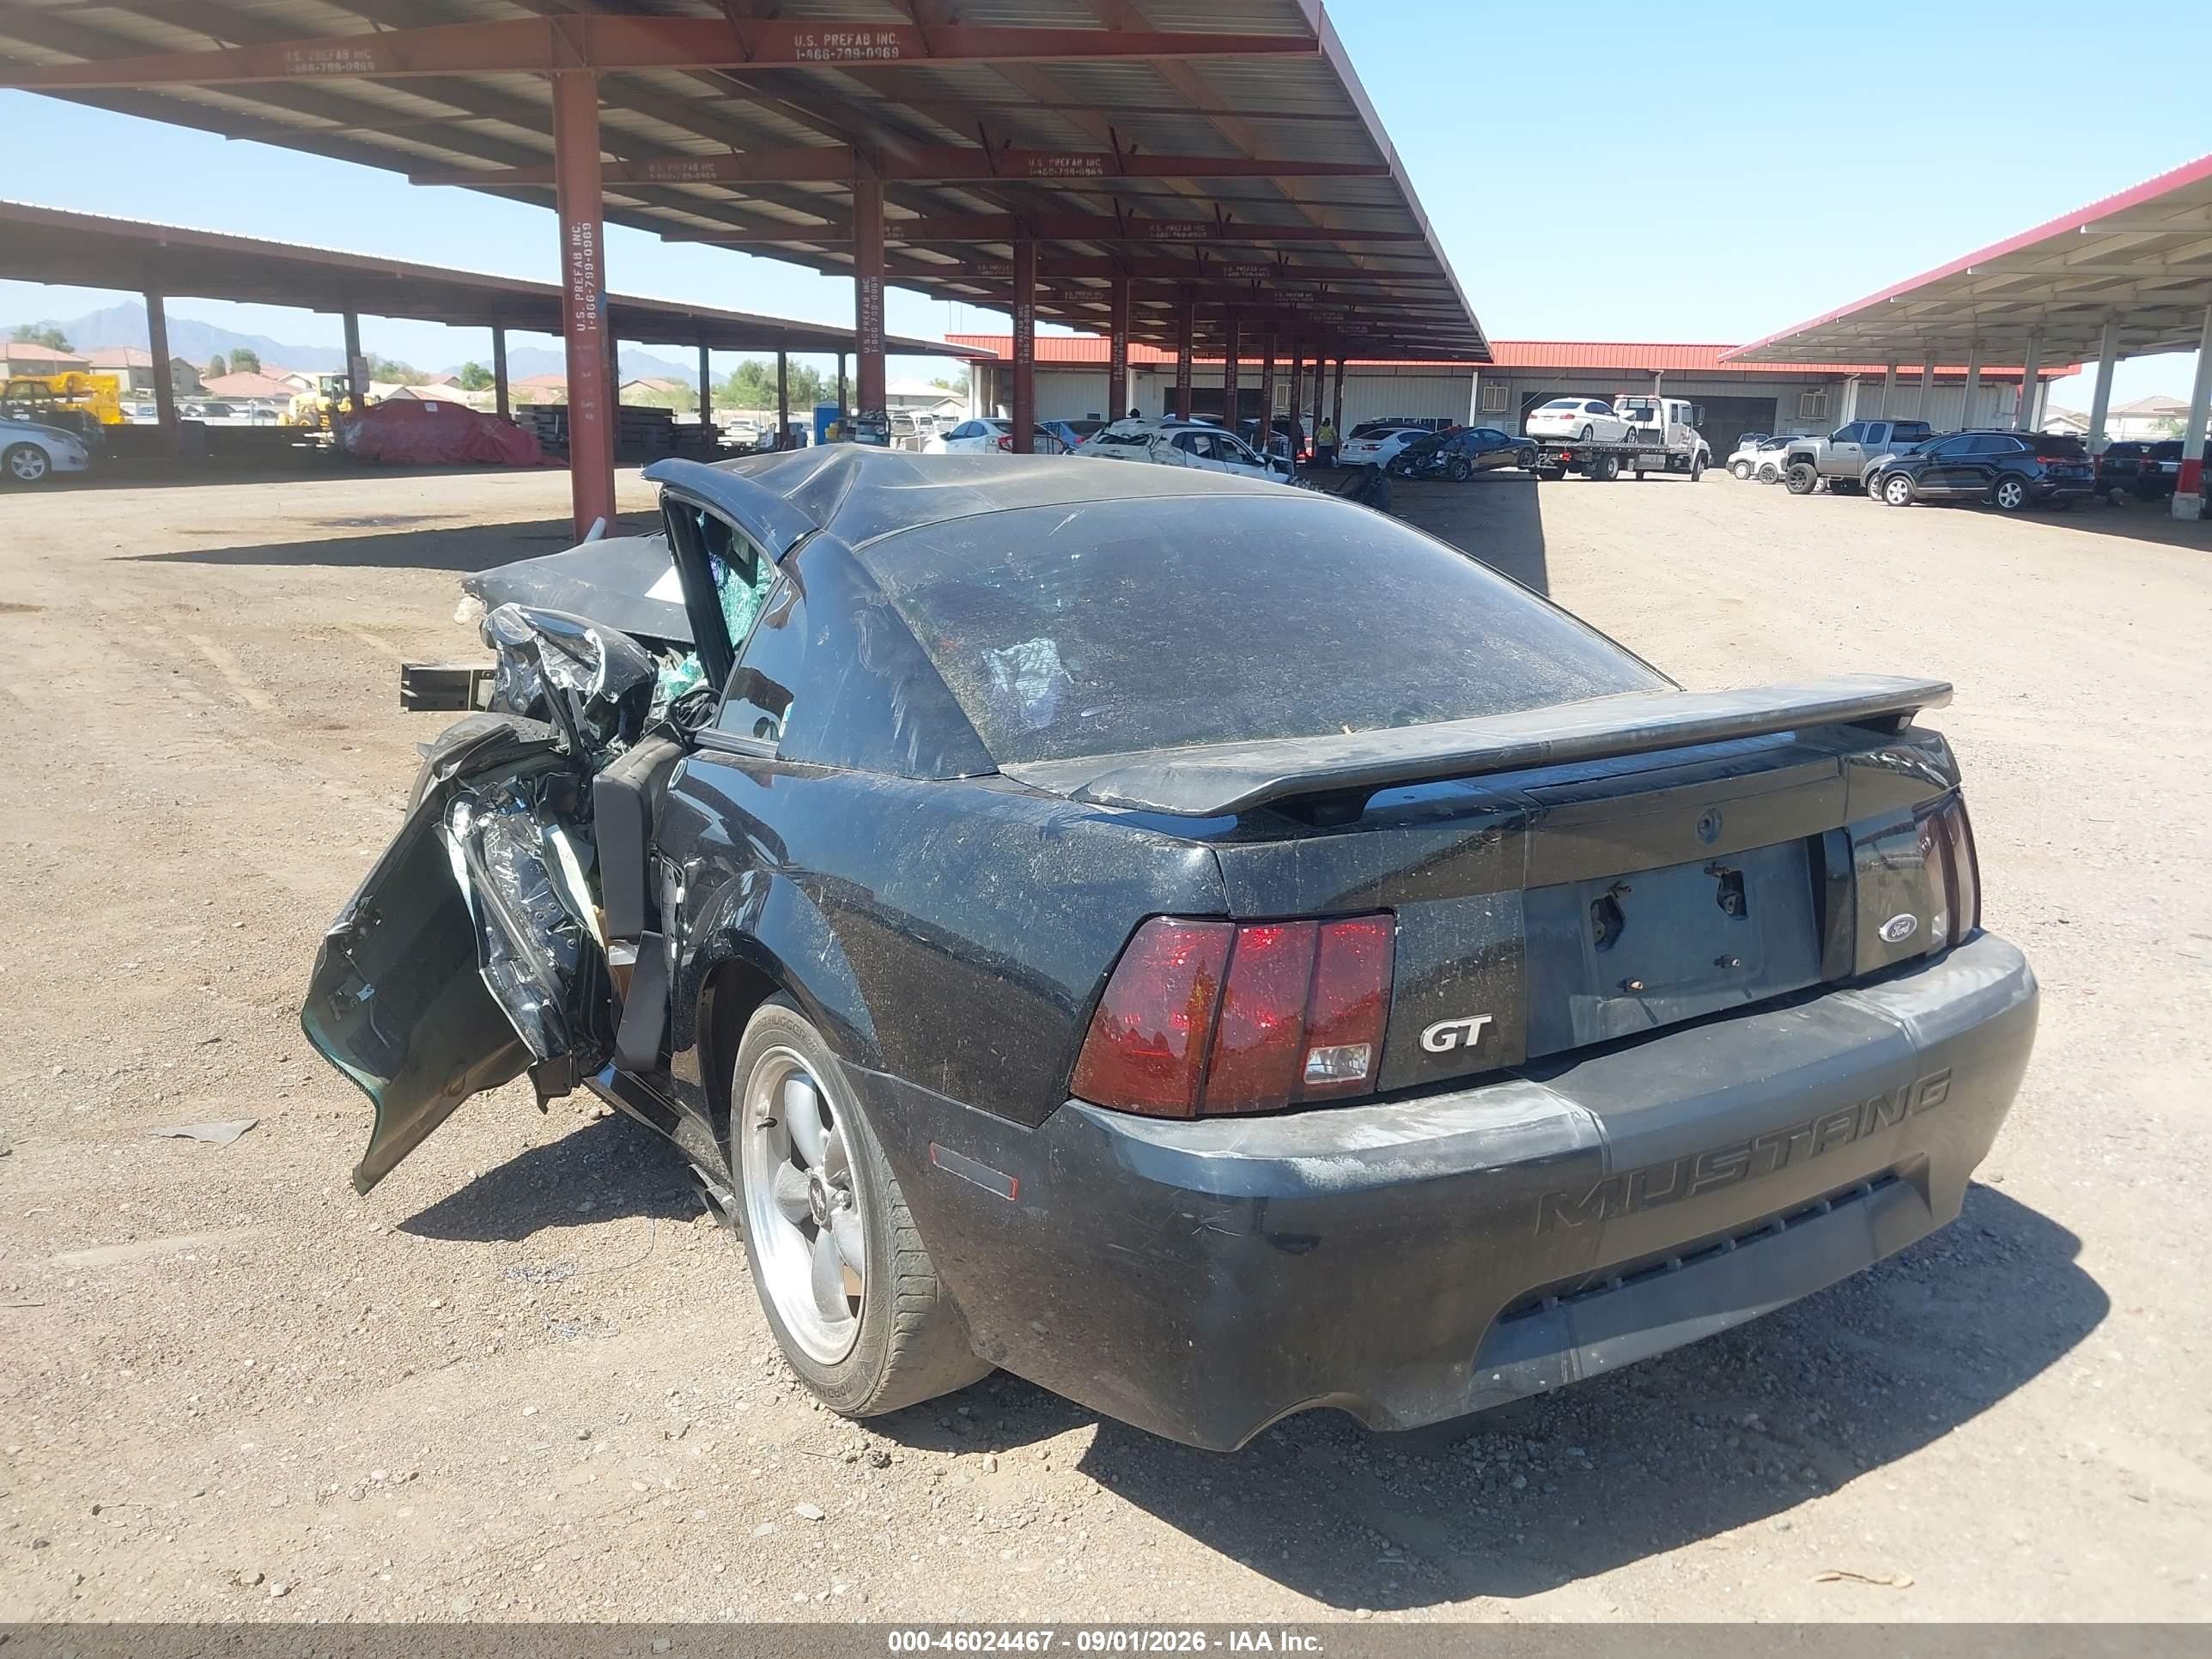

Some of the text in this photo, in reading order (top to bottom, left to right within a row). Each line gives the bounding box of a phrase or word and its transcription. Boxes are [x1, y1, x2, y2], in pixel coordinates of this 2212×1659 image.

[794, 32, 900, 47] U.S. PREFAB INC.
[571, 222, 581, 246] INC.
[573, 252, 584, 301] PREFAB
[582, 222, 597, 330] 1-866-799-0969
[575, 307, 586, 331] U.S.
[1419, 1013, 1492, 1053] GT
[1534, 1066, 1952, 1237] MUSTANG
